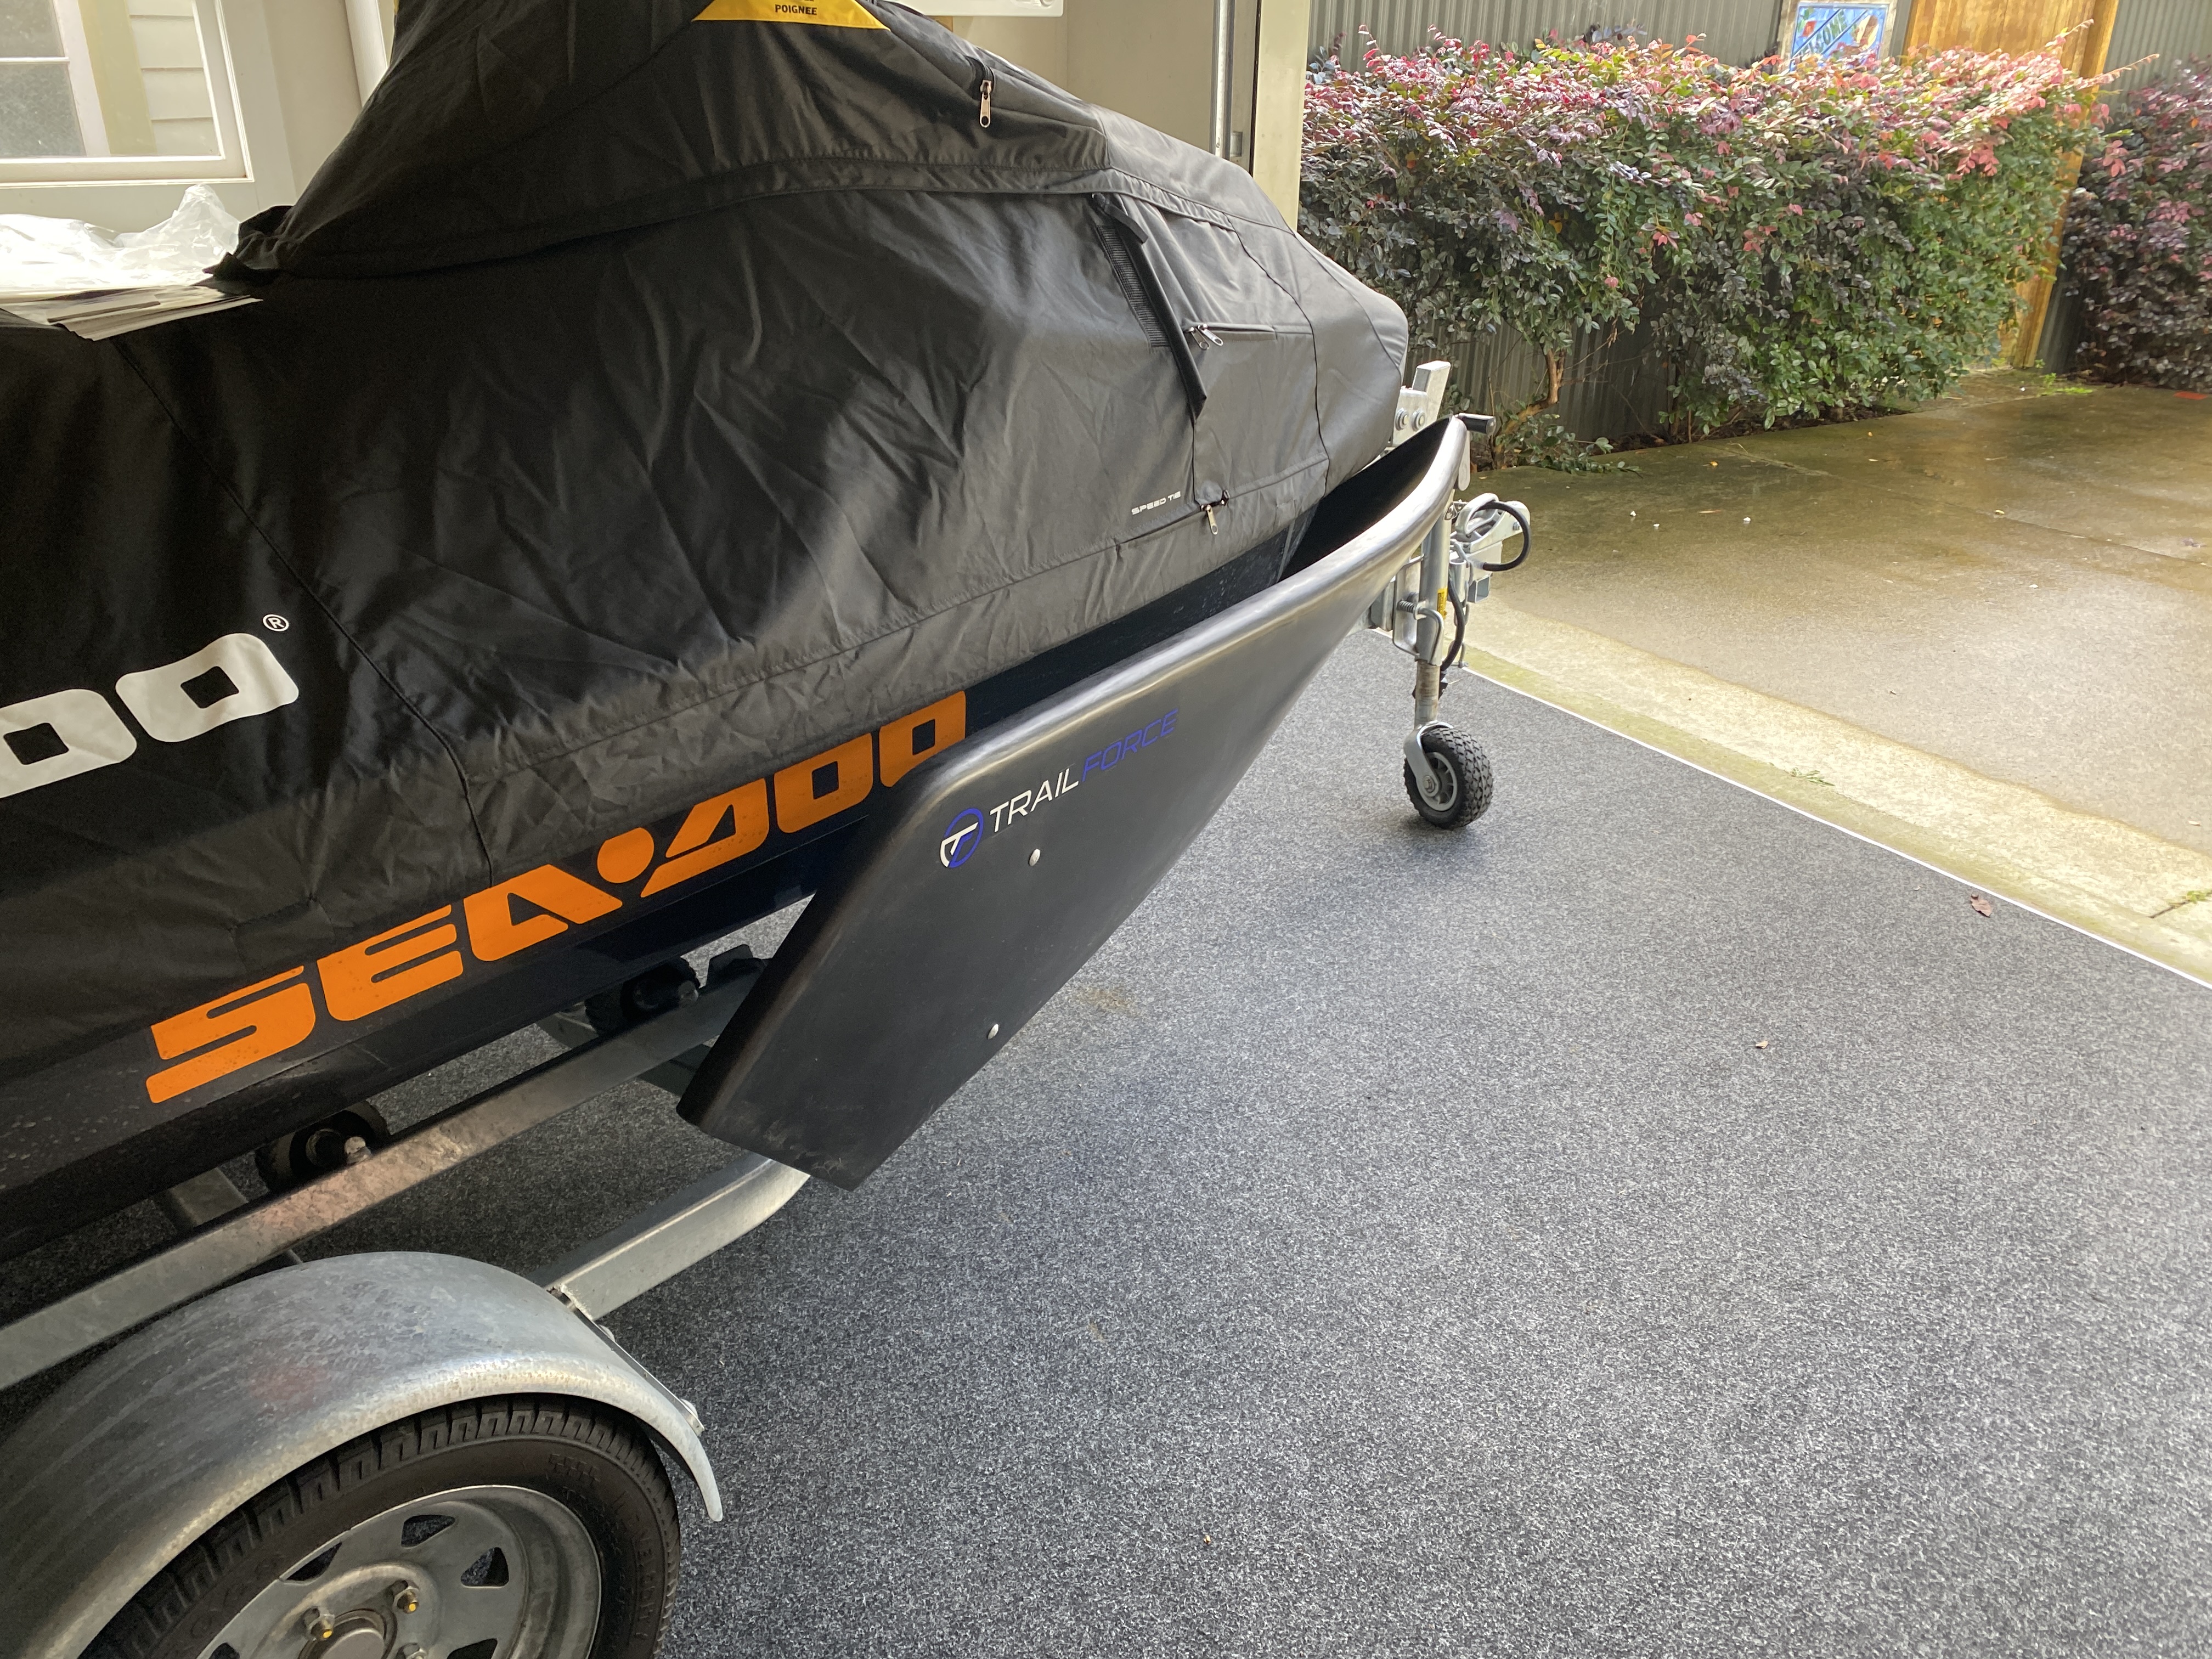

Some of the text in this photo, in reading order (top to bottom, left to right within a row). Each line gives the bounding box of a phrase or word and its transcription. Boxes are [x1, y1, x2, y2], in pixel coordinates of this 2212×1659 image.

[775, 4, 817, 15] POIGNEE
[1131, 490, 1181, 515] SPEED TIE
